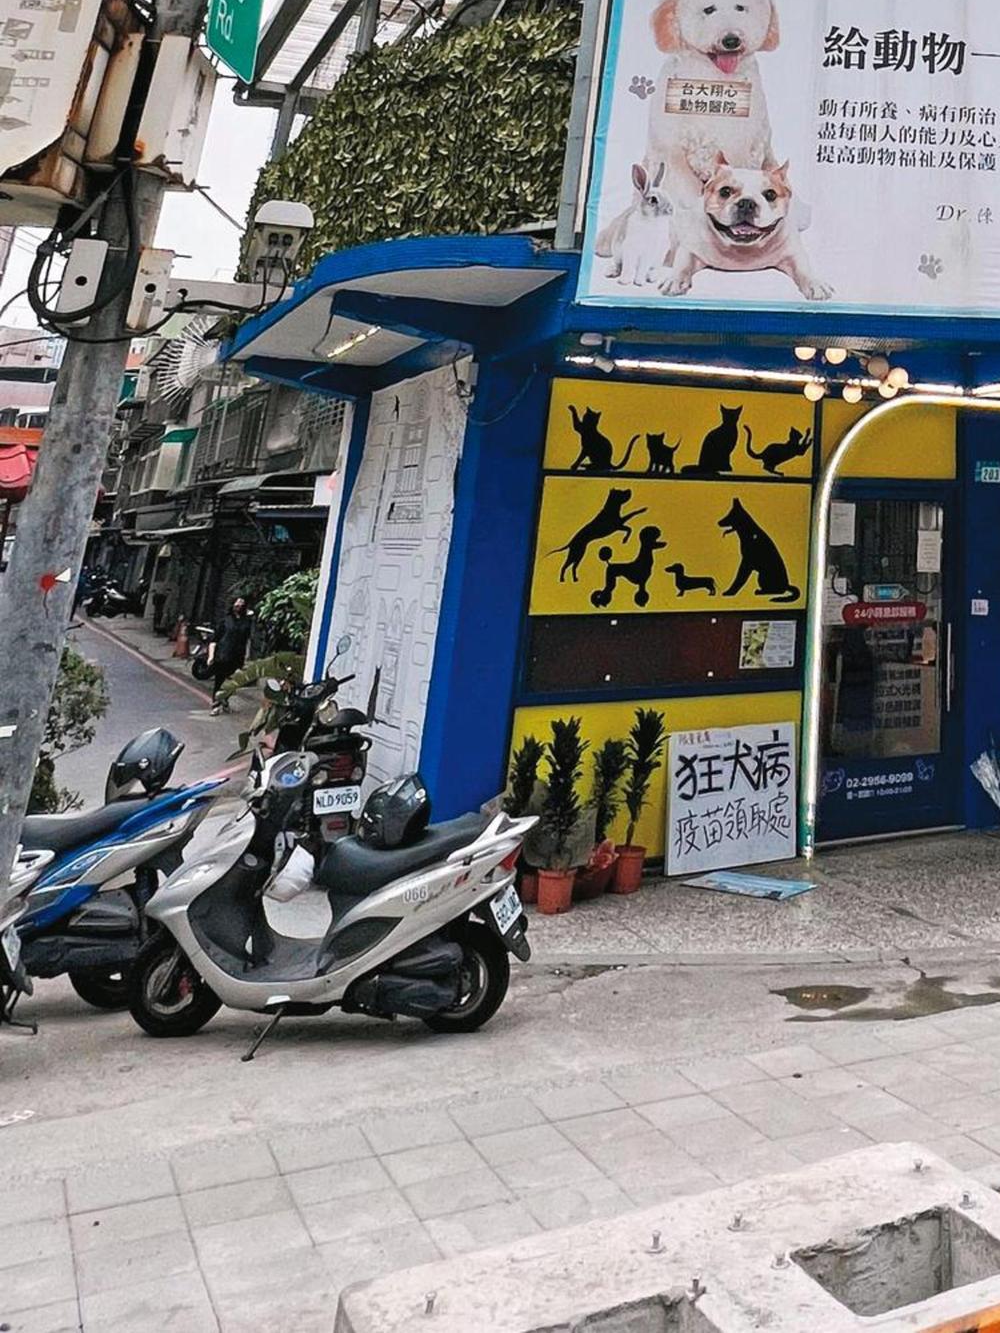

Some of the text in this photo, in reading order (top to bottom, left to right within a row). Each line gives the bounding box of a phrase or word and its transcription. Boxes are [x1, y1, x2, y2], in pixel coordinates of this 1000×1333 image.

[679, 99, 737, 114] 動物醫院
[682, 83, 738, 98] 台大翔心
[675, 729, 791, 801] 狂犬病
[675, 791, 792, 859] 疫苗領取處
